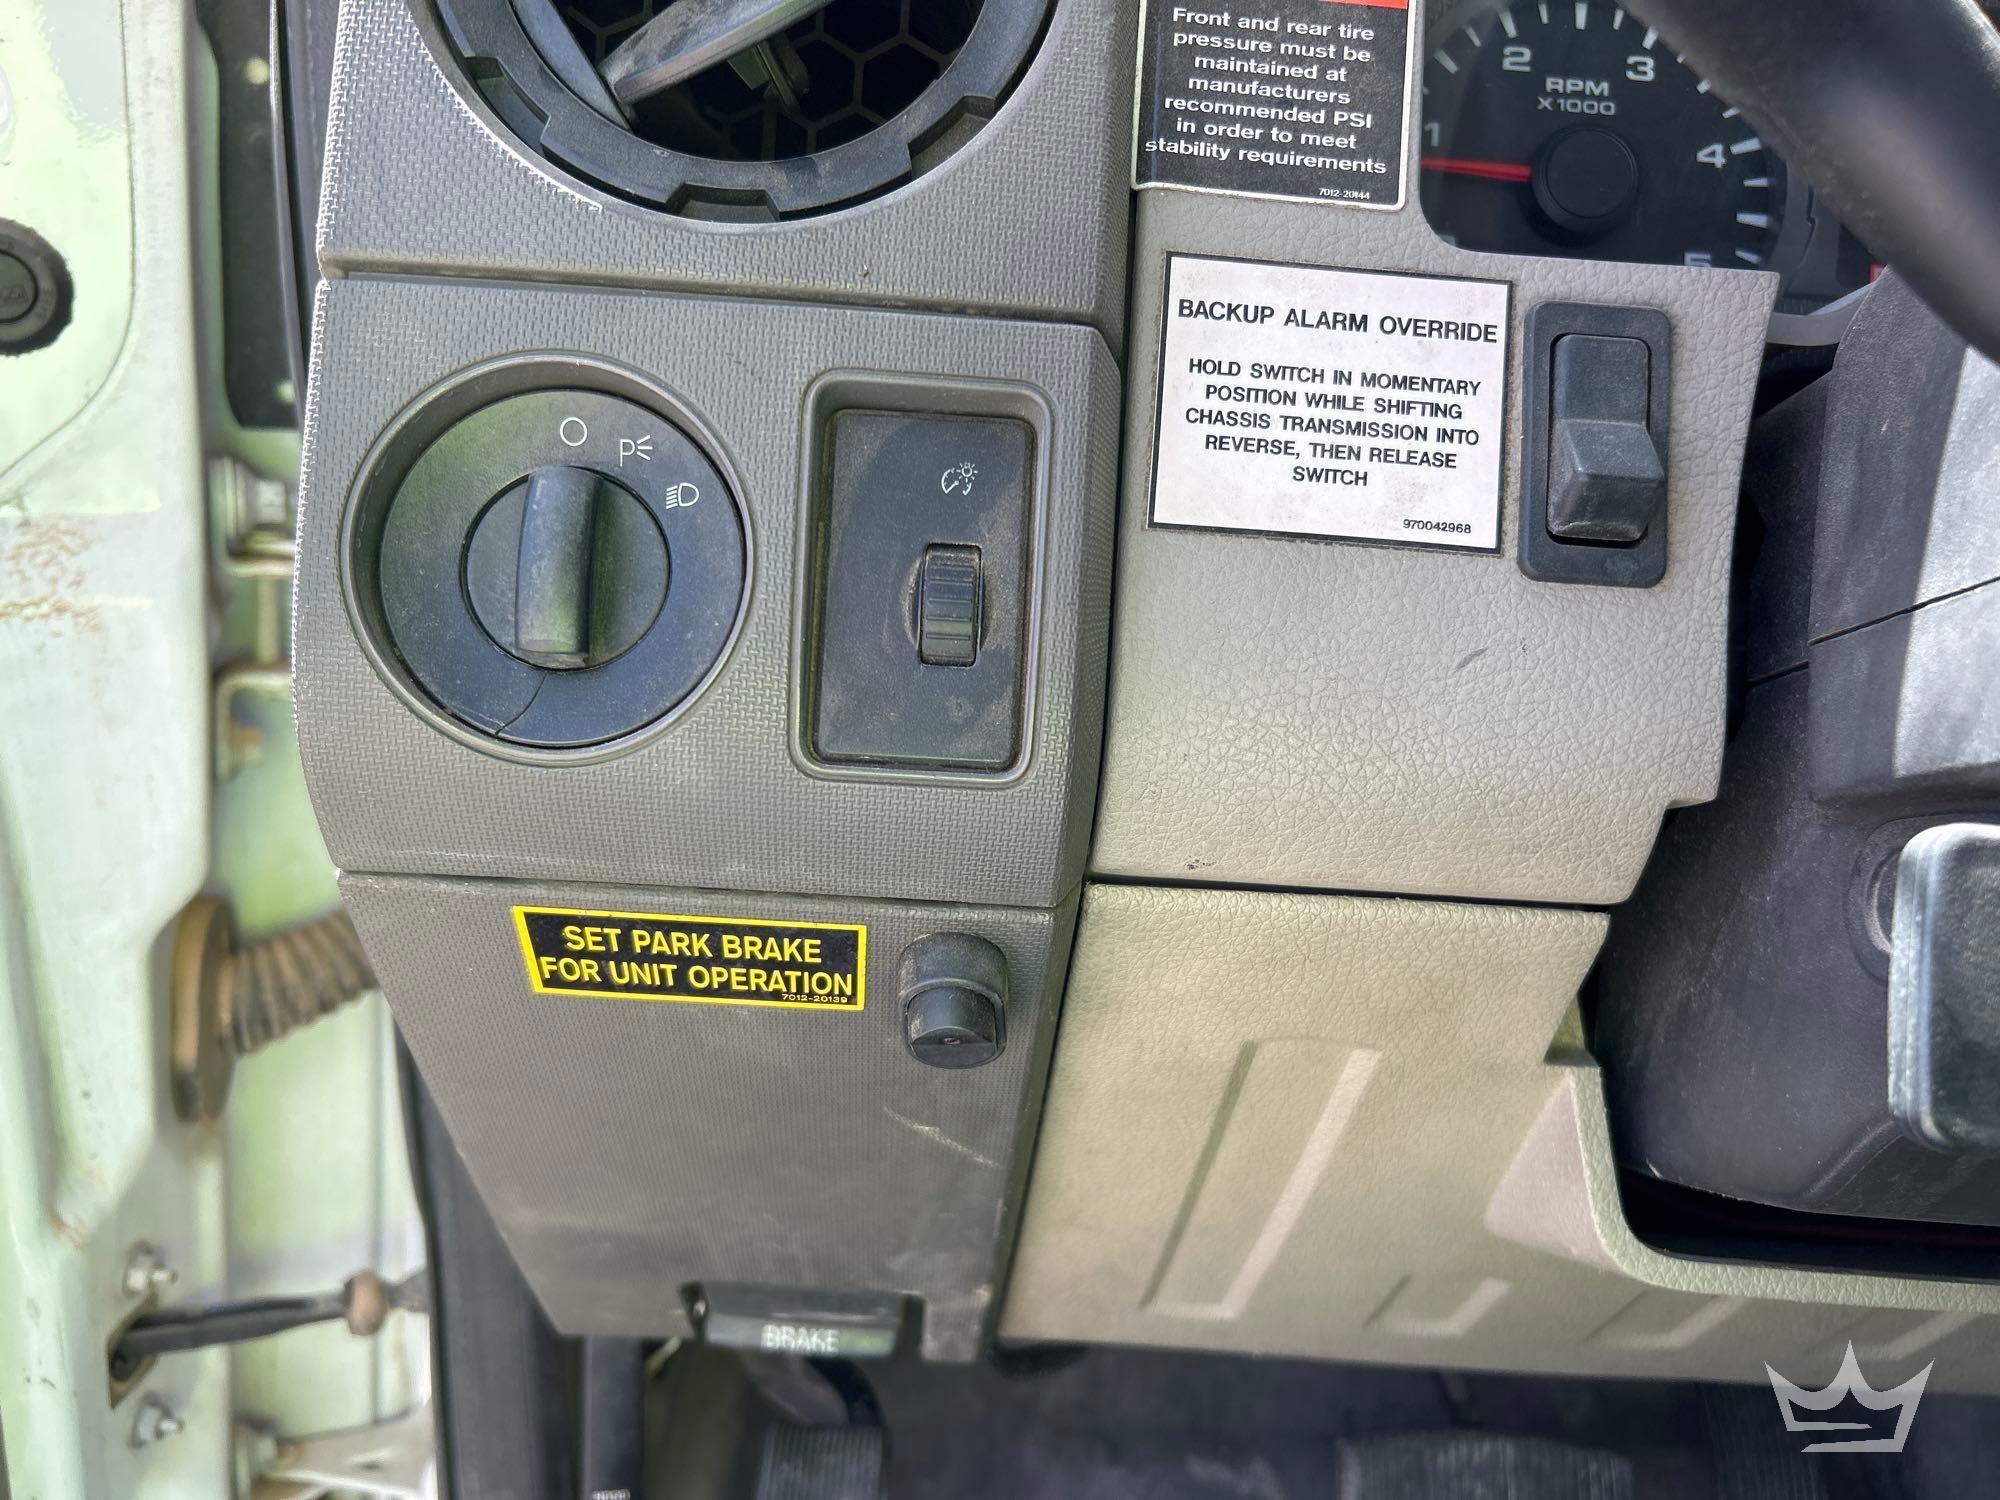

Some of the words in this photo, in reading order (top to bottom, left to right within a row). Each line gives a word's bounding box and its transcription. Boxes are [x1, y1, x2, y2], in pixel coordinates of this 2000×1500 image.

[1173, 7, 1230, 27] Front
[1238, 15, 1279, 32] and
[1287, 20, 1331, 37] rear
[1338, 24, 1375, 41] tire
[1173, 32, 1272, 53] pressure
[1280, 43, 1336, 60] must
[1343, 46, 1371, 62] be
[1502, 46, 1531, 73] 2
[1194, 55, 1318, 80] maintained
[1325, 67, 1347, 82] at
[1625, 55, 1656, 82] 3
[1188, 77, 1351, 105] manufacturers
[1545, 77, 1610, 97] RPM
[1164, 97, 1325, 124] recommended
[1334, 110, 1372, 129] PSI
[1536, 97, 1617, 117] X1000
[1176, 117, 1195, 133] in
[1204, 122, 1263, 140] order
[1271, 128, 1292, 143] to
[1300, 133, 1357, 149] meet
[1424, 122, 1440, 147] 1
[1145, 138, 1230, 161] stability
[1238, 149, 1387, 174] requirements
[1696, 143, 1728, 169] 4
[1178, 298, 1275, 324] BACKUP
[1283, 308, 1368, 333] ALARM
[1379, 316, 1498, 343] OVERRIDE
[1189, 358, 1241, 377] HOLD
[1250, 363, 1324, 384] SWITCH
[1333, 369, 1352, 385] IN
[1360, 372, 1481, 396] MOMENTARY
[1205, 384, 1297, 406] POSITION
[1304, 392, 1364, 411] WHILE
[1373, 397, 1462, 419] SHIFTING
[1185, 407, 1271, 429] CHASSIS
[1279, 415, 1428, 441] TRANSMISSION
[1436, 428, 1480, 446] INTO
[1205, 434, 1301, 458] REVERSE,
[1308, 442, 1362, 461] THEN
[1369, 447, 1457, 469] RELEASE
[1292, 466, 1368, 486] SWITCH
[1402, 518, 1471, 534] 970042968
[563, 925, 621, 953] SET
[633, 929, 713, 959] PARK
[722, 935, 822, 964] BRAKE
[539, 955, 601, 984] FOR
[608, 960, 678, 988] UNIT
[692, 966, 852, 996] OPERATION
[782, 993, 848, 1003] 7012-20139
[761, 1323, 840, 1353] BRAKE
